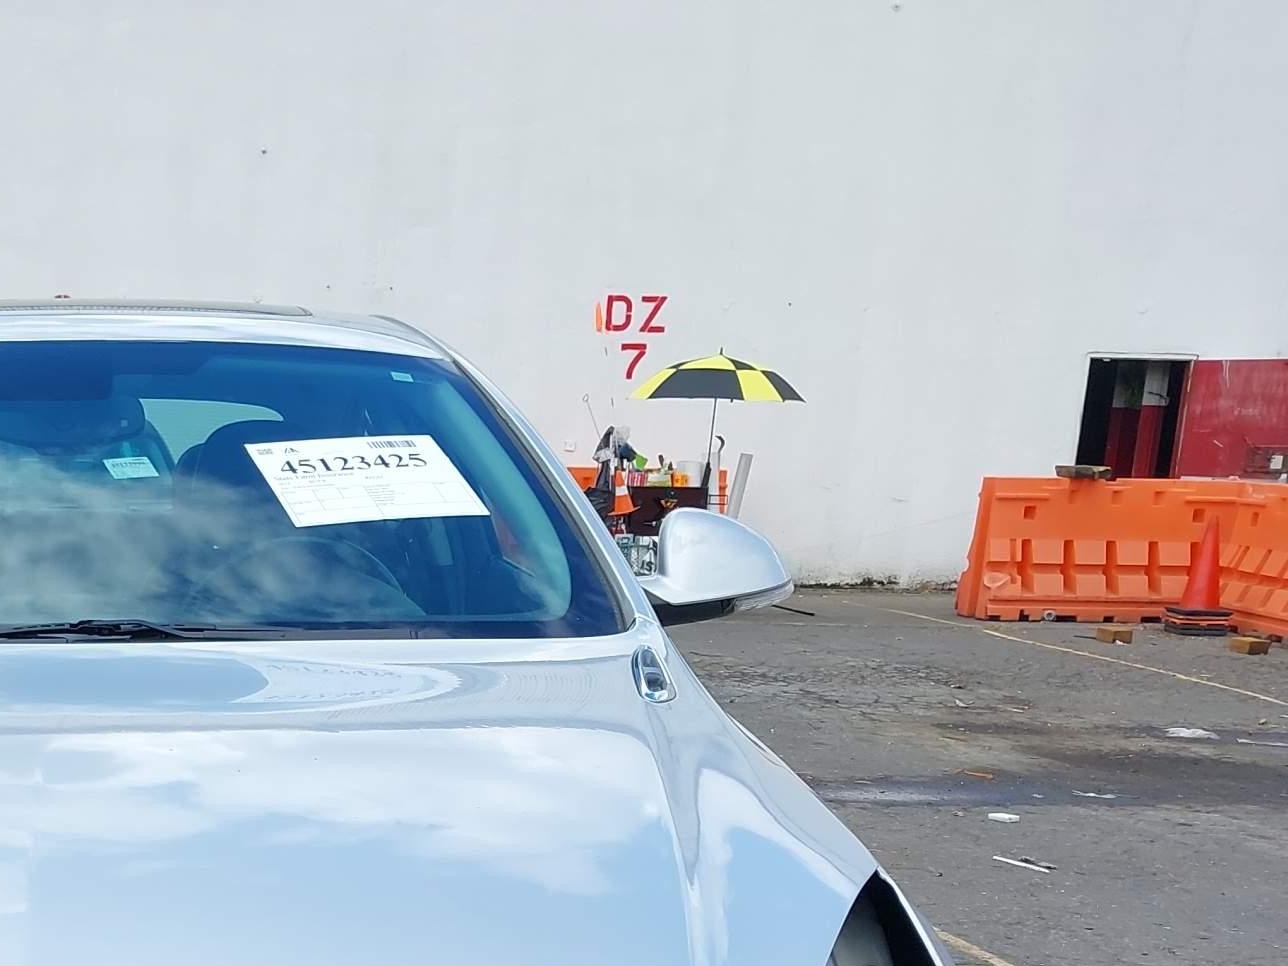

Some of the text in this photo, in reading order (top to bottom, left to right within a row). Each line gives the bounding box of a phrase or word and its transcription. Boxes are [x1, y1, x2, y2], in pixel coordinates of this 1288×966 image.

[606, 295, 668, 333] DZ
[621, 343, 647, 380] 7
[280, 453, 428, 474] 45123425
